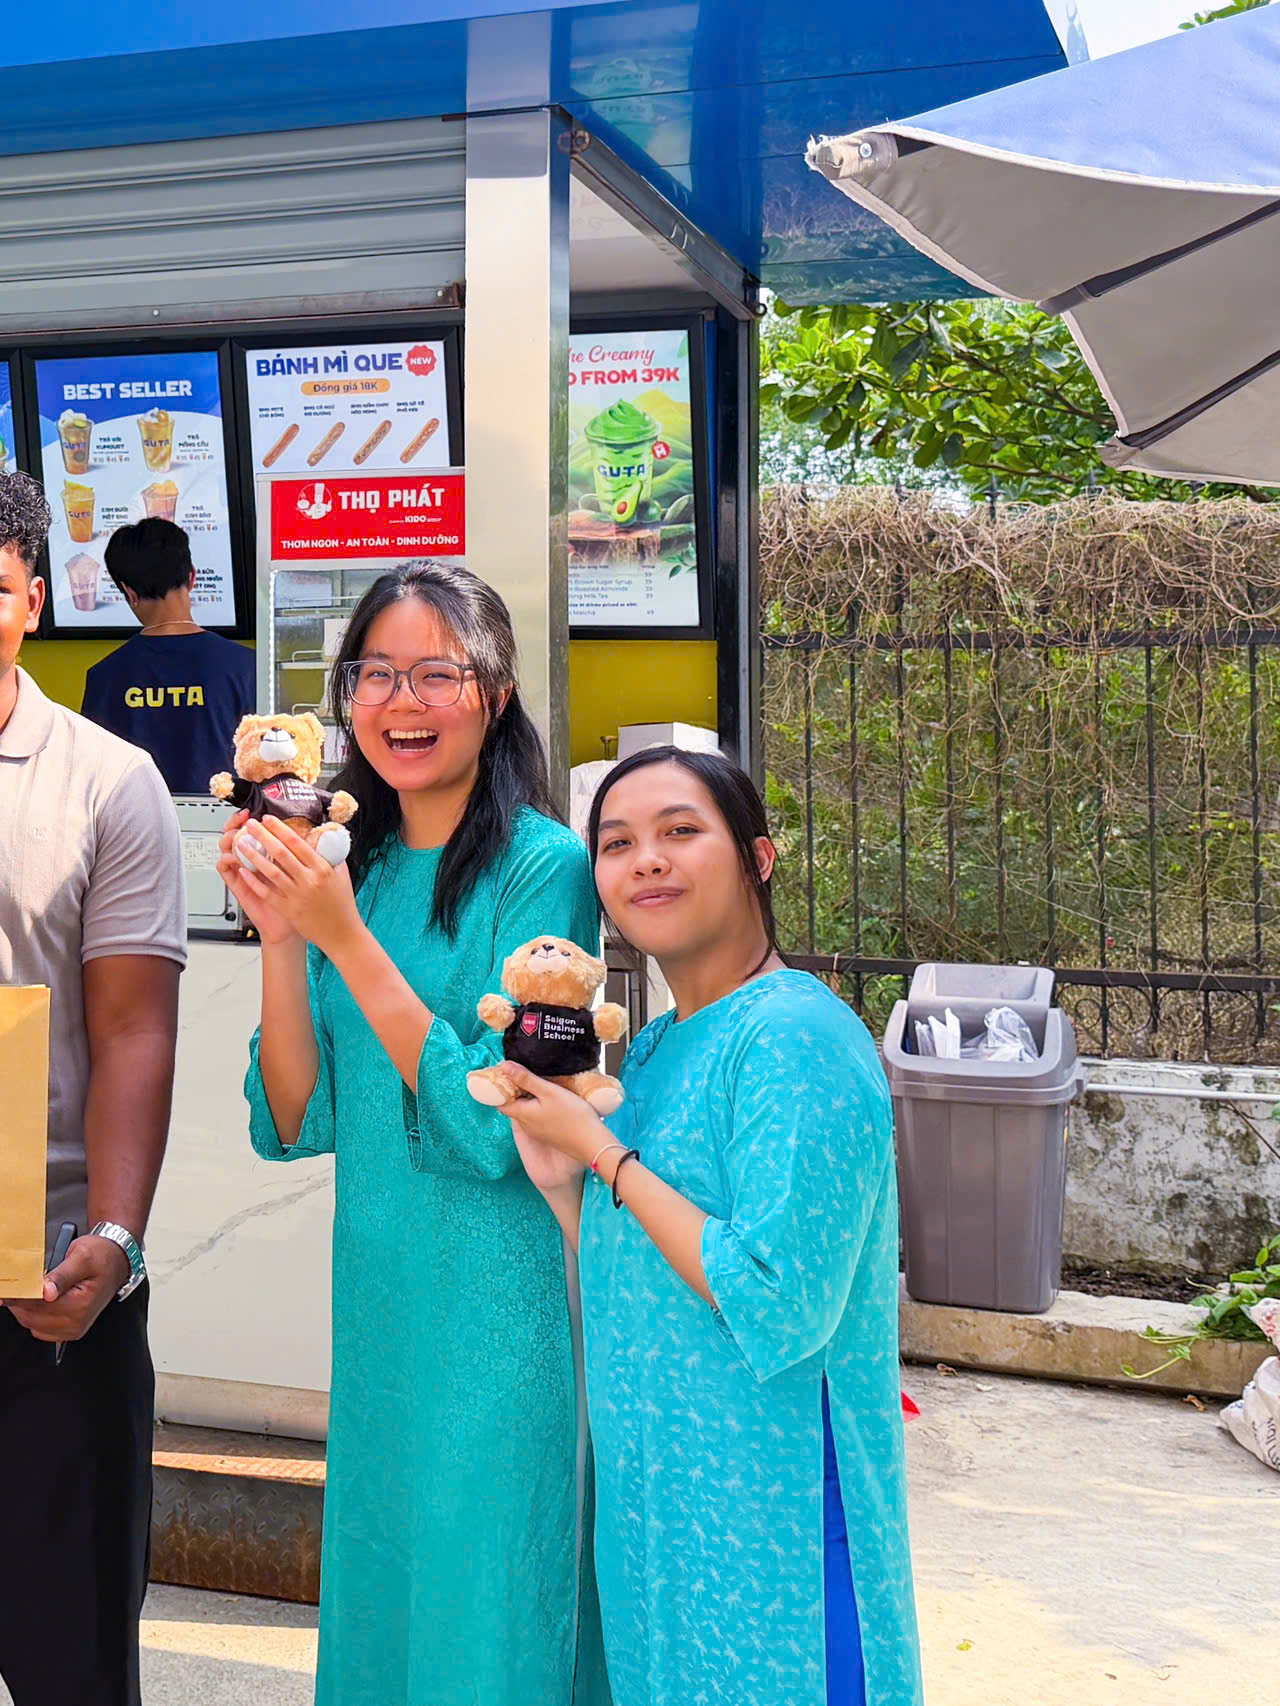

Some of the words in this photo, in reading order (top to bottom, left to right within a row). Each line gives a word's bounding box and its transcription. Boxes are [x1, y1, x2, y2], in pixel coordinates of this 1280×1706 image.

[410, 356, 432, 366] NEW
[589, 345, 656, 366] Creamy
[256, 354, 319, 377] BÁNH
[323, 350, 349, 374] MÌ
[354, 352, 403, 373] QUE
[581, 369, 638, 386] FROM
[641, 367, 680, 383] 39K
[63, 382, 115, 400] BEST
[119, 380, 193, 399] SELLER
[343, 381, 358, 392] giá
[598, 464, 646, 478] GUTA
[338, 490, 380, 514] THỌ
[388, 482, 445, 509] PHÁT
[404, 515, 426, 523] KIDO
[281, 539, 311, 549] THƠM
[312, 538, 339, 548] NGON
[346, 538, 358, 547] AN
[359, 535, 389, 547] TOÀN
[396, 536, 420, 546] DINH
[421, 534, 459, 545] DƯỠNG
[124, 686, 205, 708] GUTA
[545, 1014, 576, 1026] Saigon
[544, 1023, 585, 1035] Business
[543, 1032, 575, 1041] School
